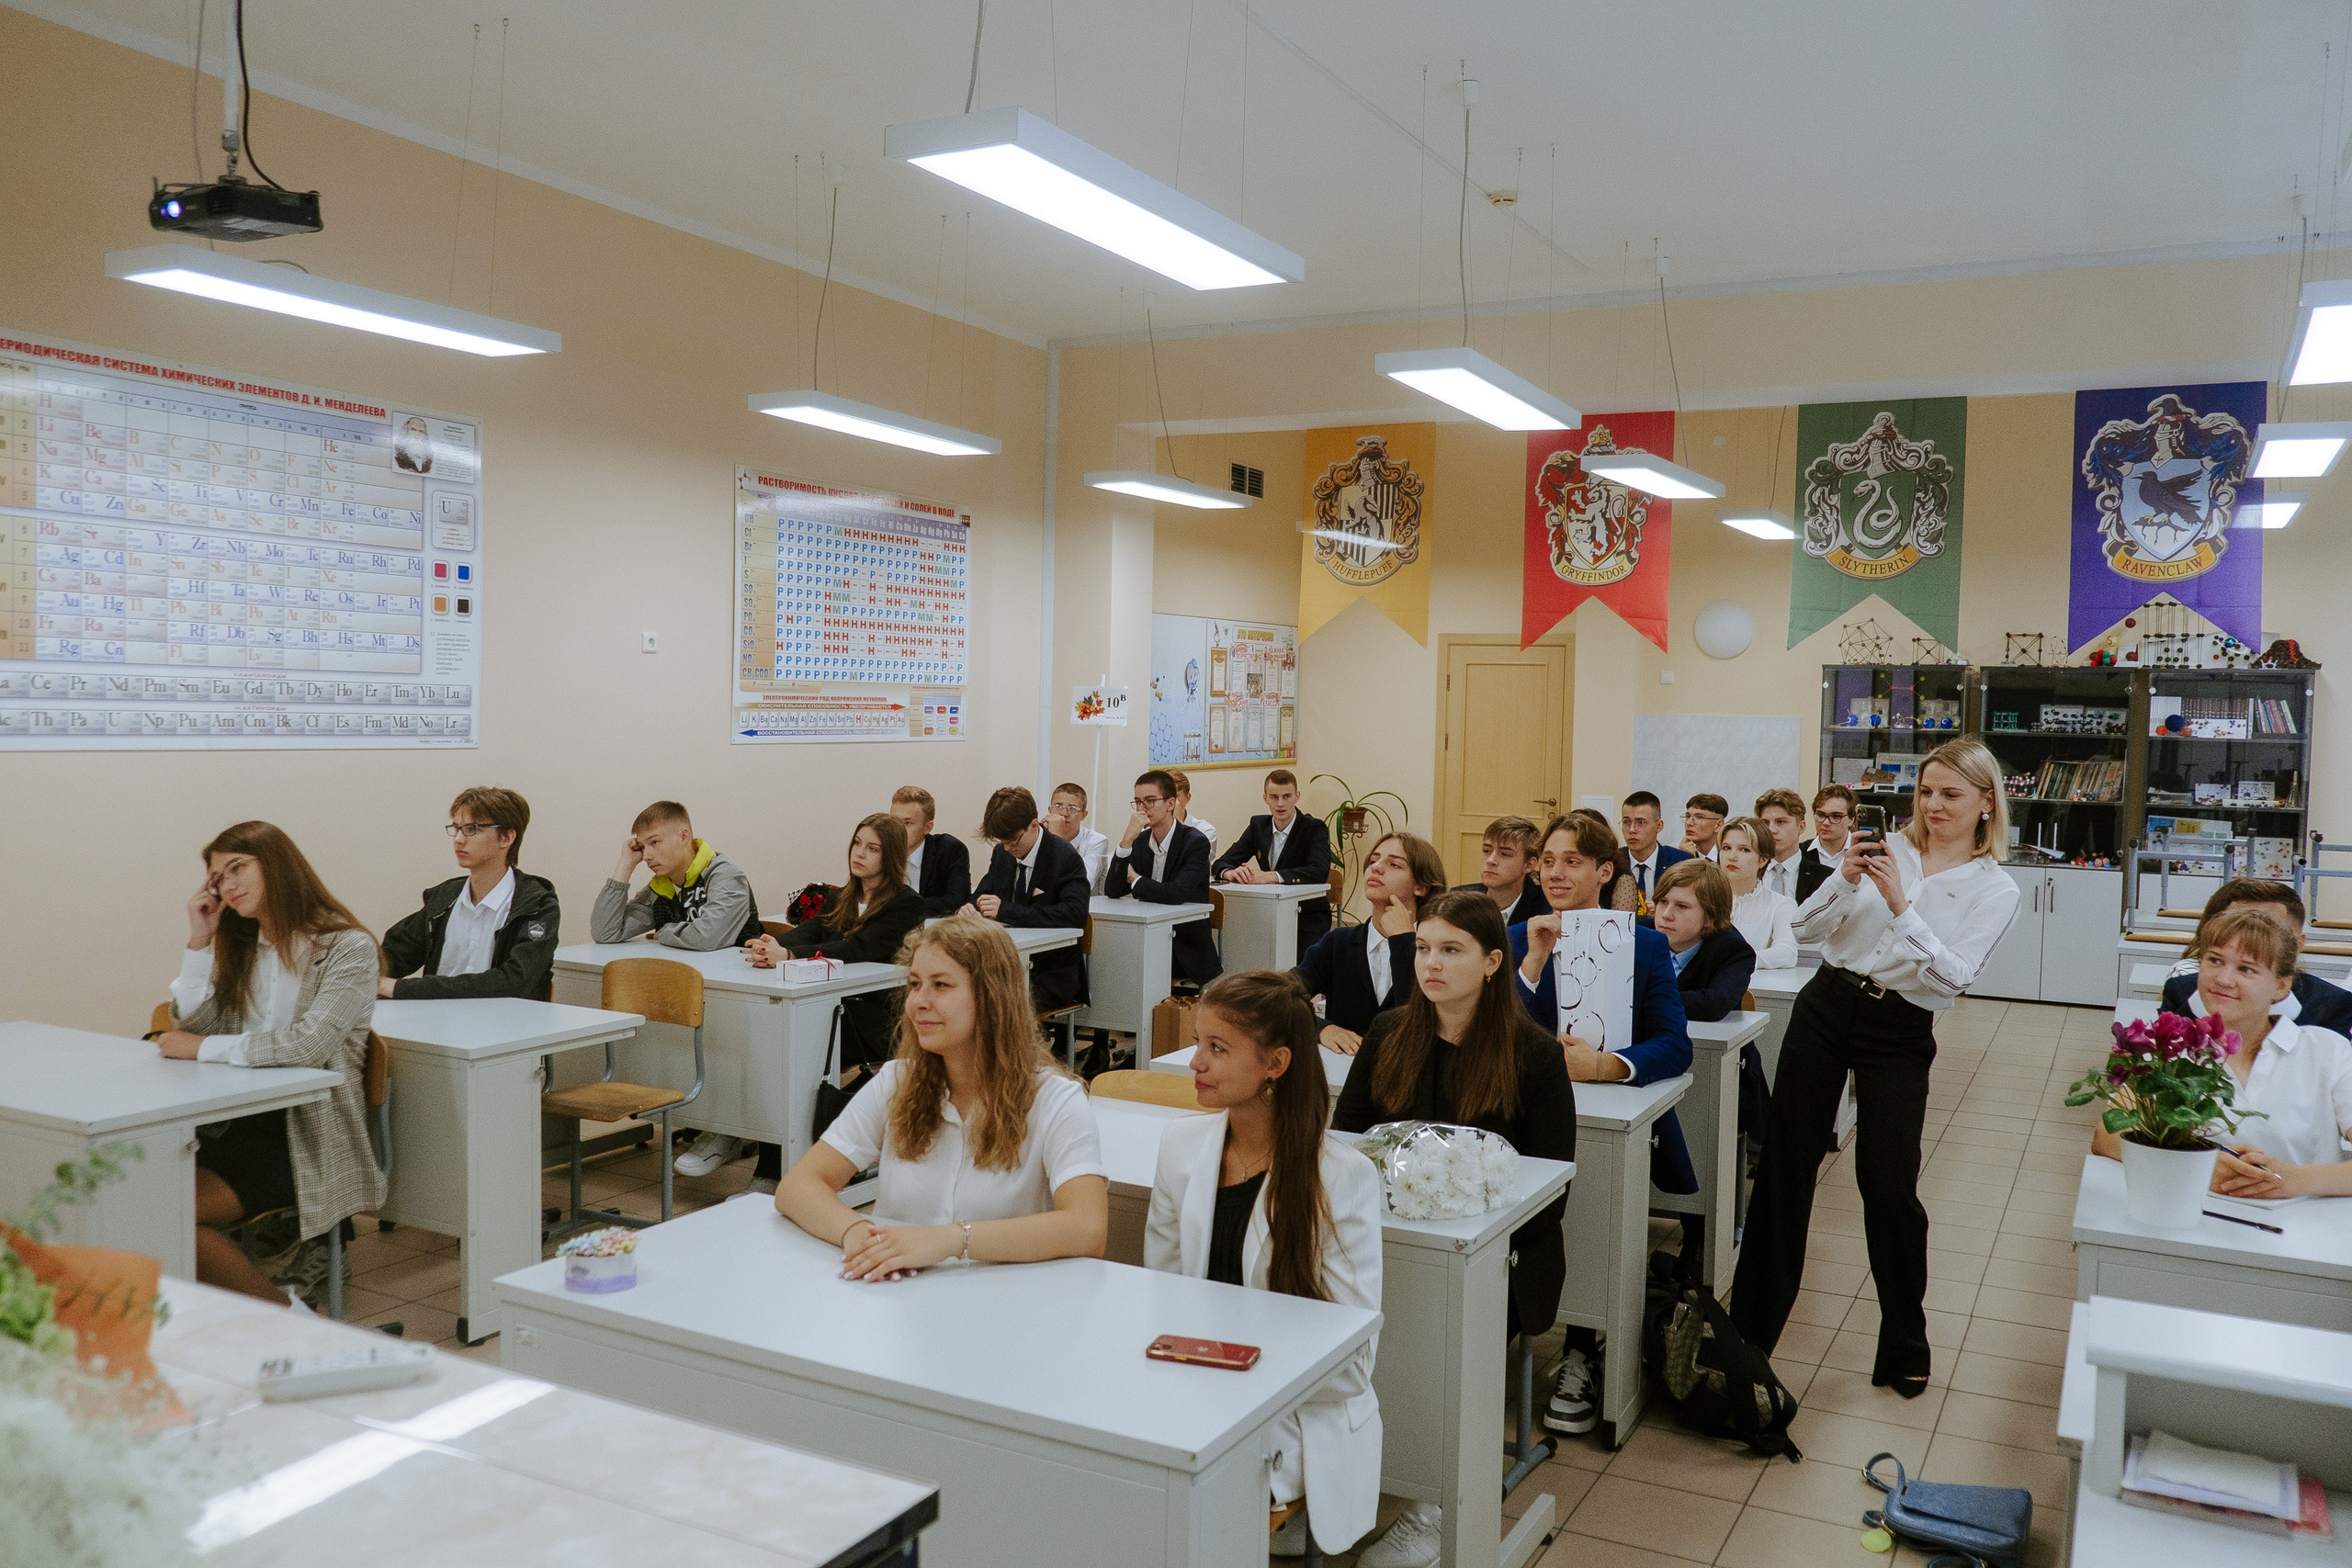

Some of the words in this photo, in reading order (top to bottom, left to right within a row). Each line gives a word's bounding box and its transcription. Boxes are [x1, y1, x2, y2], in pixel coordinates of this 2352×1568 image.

[103, 357, 158, 378] СИСТЕМА
[161, 367, 235, 391] ХИМИЧЕСКИХ
[238, 382, 299, 402] ЭЛЕМЕНТОВ
[301, 393, 311, 406] Д.
[313, 396, 322, 407] И.
[324, 398, 386, 418] МЕНДЕЛЕЕВА
[323, 439, 338, 452] He
[323, 460, 336, 473] Ne
[323, 480, 336, 493] Ar
[85, 470, 102, 484] Ca
[300, 498, 318, 512] Mn
[342, 503, 354, 515] Fe
[373, 507, 387, 520] Co
[410, 512, 421, 524] Ni
[758, 476, 827, 495] РАСТВОРИМОСТЬ
[905, 502, 909, 510] И
[910, 502, 931, 512] СОЛЕЙ
[933, 506, 937, 514] В
[938, 508, 955, 517] ВОДЕ
[61, 491, 79, 504] Cu
[106, 496, 123, 510] Zn
[323, 522, 337, 534] Kr
[442, 501, 450, 513] U
[105, 550, 123, 564] Cd
[338, 552, 353, 564] Ru
[372, 555, 386, 567] Rh
[408, 558, 420, 570] Pd
[1838, 555, 1910, 575] SLYTHERIN
[1332, 560, 1393, 580] HUFFLEPUFF
[1562, 565, 1627, 581] GRYFFINDOR
[2121, 557, 2203, 577] RAVENCLAW
[85, 572, 100, 586] Ba
[188, 581, 206, 593] Hf
[232, 583, 244, 596] Ta
[305, 590, 318, 602] Re
[338, 592, 353, 604] Os
[410, 598, 420, 609] Pt
[60, 593, 79, 607] Au
[103, 596, 123, 613] Hg
[322, 611, 336, 623] Rn
[60, 639, 79, 656] Rg
[105, 642, 123, 655] Cn
[303, 630, 317, 642] Bh
[338, 633, 352, 644] Hs
[407, 637, 420, 648] Ds
[31, 675, 51, 689] Ce
[71, 676, 86, 690] Pr
[145, 678, 167, 692] Pm
[213, 680, 230, 694] Eu
[244, 681, 263, 694] Gd
[277, 682, 294, 695] Tb
[307, 682, 323, 697] Dy
[336, 683, 352, 696] Ho
[366, 684, 377, 697] Er
[393, 685, 409, 698] Tm
[421, 686, 435, 698] Yb
[447, 687, 459, 698] Lu
[31, 712, 53, 726] Th
[71, 712, 86, 726] Pa
[179, 714, 197, 727] Pu
[212, 714, 234, 727] Am
[244, 714, 266, 728] Cm
[277, 715, 291, 728] Bk
[336, 716, 349, 728] Es
[365, 716, 381, 728] Fm
[392, 716, 408, 728] Md
[420, 716, 433, 728] No
[446, 716, 457, 728] Lr
